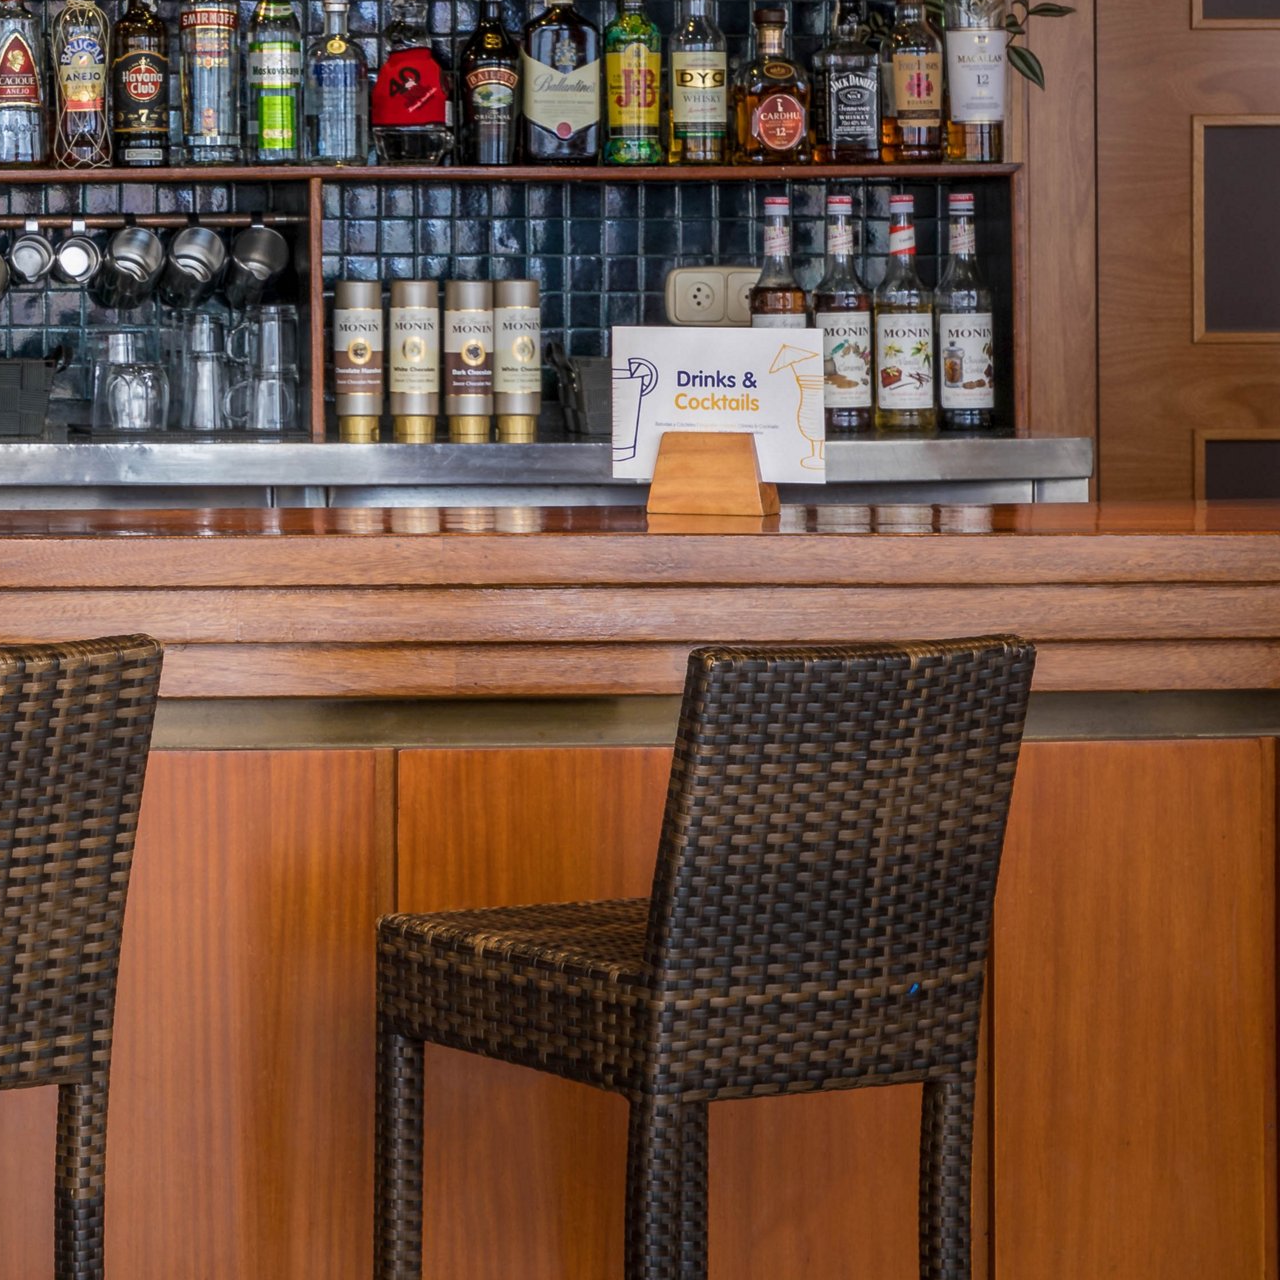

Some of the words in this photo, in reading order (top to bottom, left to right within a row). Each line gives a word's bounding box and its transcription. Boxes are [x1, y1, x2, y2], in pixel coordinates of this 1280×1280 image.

[182, 12, 235, 26] SMIRNOFF
[60, 41, 104, 64] BRUGAL
[957, 55, 1002, 64] MACALLAN
[65, 70, 100, 82] AÑEJO
[122, 71, 163, 83] Havana
[470, 70, 515, 85] BAILEYS
[680, 72, 724, 84] DYC
[976, 75, 990, 85] 12
[130, 82, 155, 93] Club
[830, 78, 849, 93] JACK
[683, 95, 721, 103] WHISKY
[138, 109, 149, 122] 7
[775, 127, 786, 137] 12
[339, 323, 379, 332] MONIN
[452, 324, 492, 333] MONIN
[824, 327, 869, 337] MONIN
[883, 327, 930, 338] MONIN
[677, 370, 736, 388] Drinks
[742, 372, 757, 388] &
[674, 393, 760, 411] Cocktails
